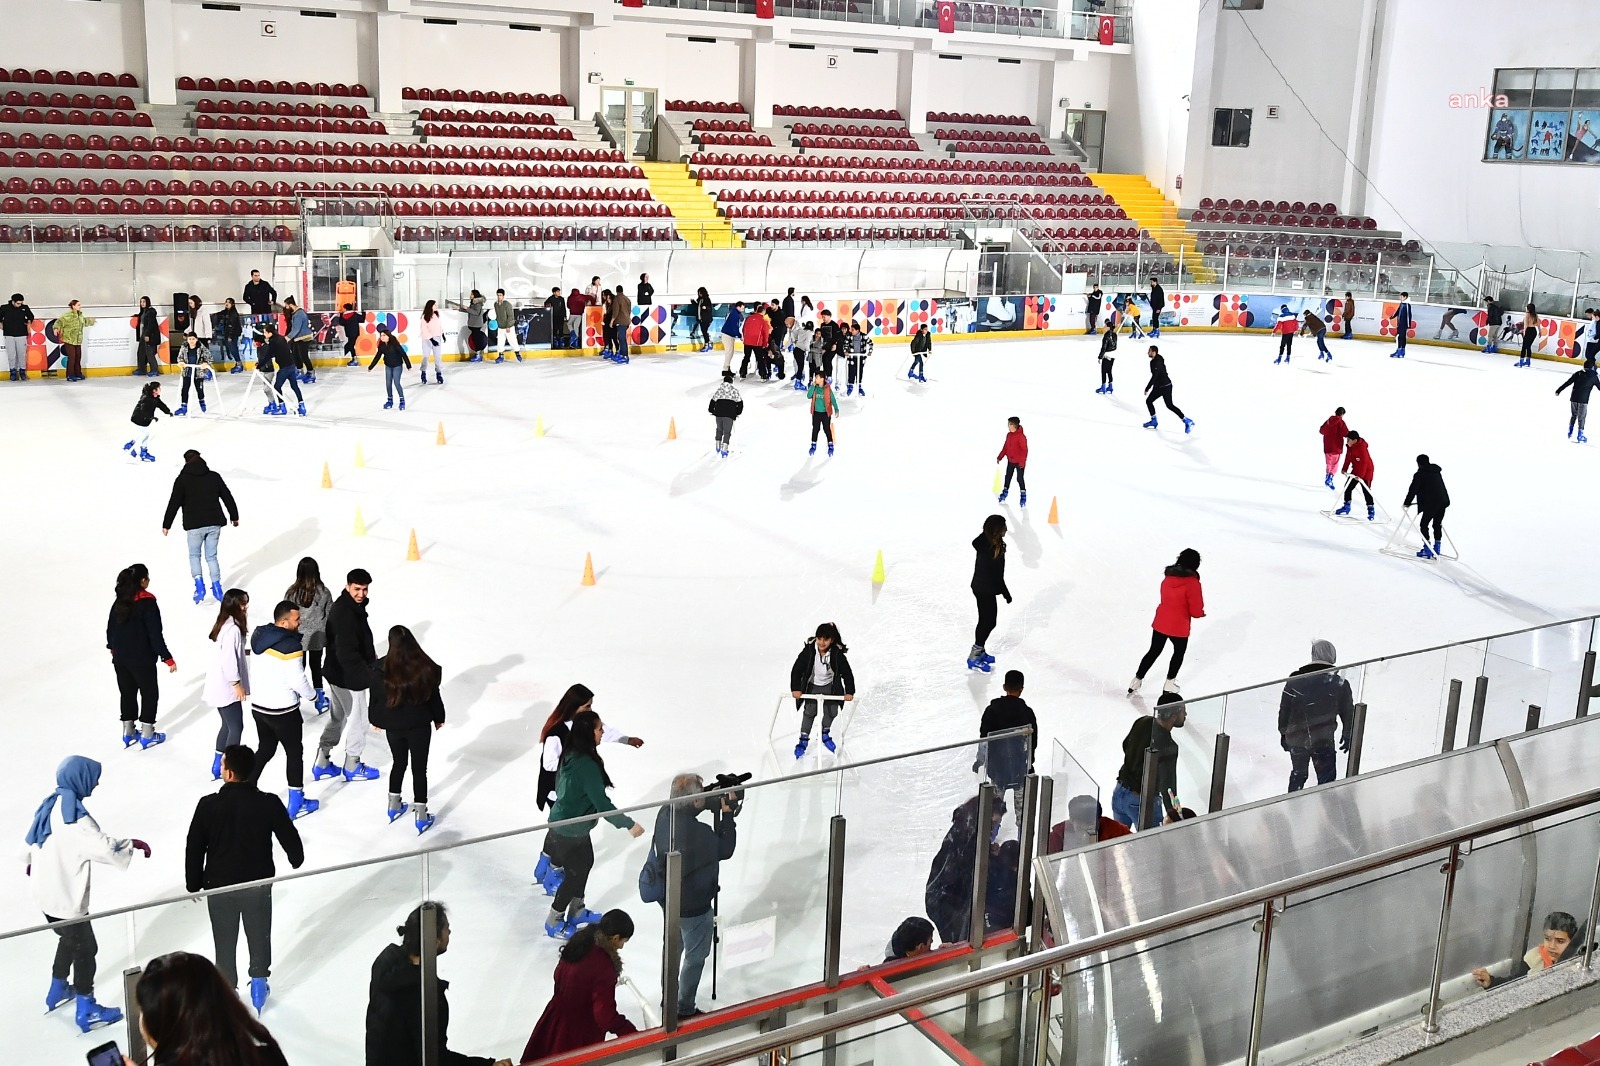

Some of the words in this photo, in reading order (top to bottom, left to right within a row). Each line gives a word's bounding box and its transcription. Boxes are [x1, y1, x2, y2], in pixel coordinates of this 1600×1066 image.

[264, 24, 274, 35] C
[829, 57, 836, 66] D
[1269, 107, 1277, 116] E
